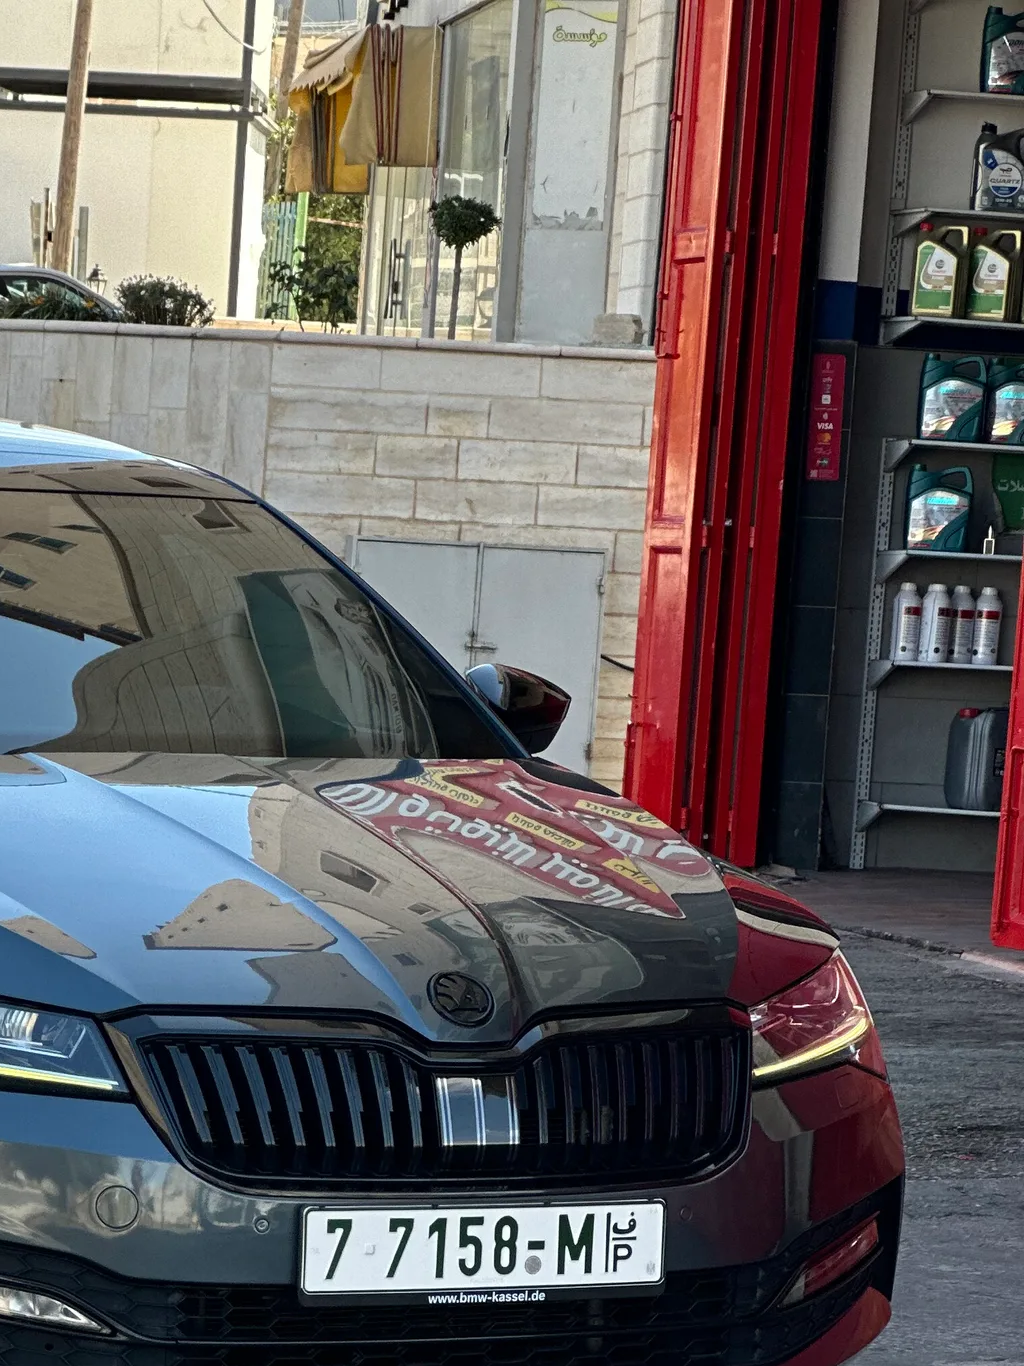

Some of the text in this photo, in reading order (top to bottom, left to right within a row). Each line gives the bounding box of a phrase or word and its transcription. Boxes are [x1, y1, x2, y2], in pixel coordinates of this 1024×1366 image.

[553, 25, 607, 48] مؤسسة
[989, 178, 1021, 186] QUARTZ
[817, 422, 834, 431] VISA
[612, 1211, 637, 1235] ف
[325, 1218, 353, 1280] 7
[612, 1243, 633, 1272] P
[428, 1291, 546, 1304] www.bmw-kassel.de
